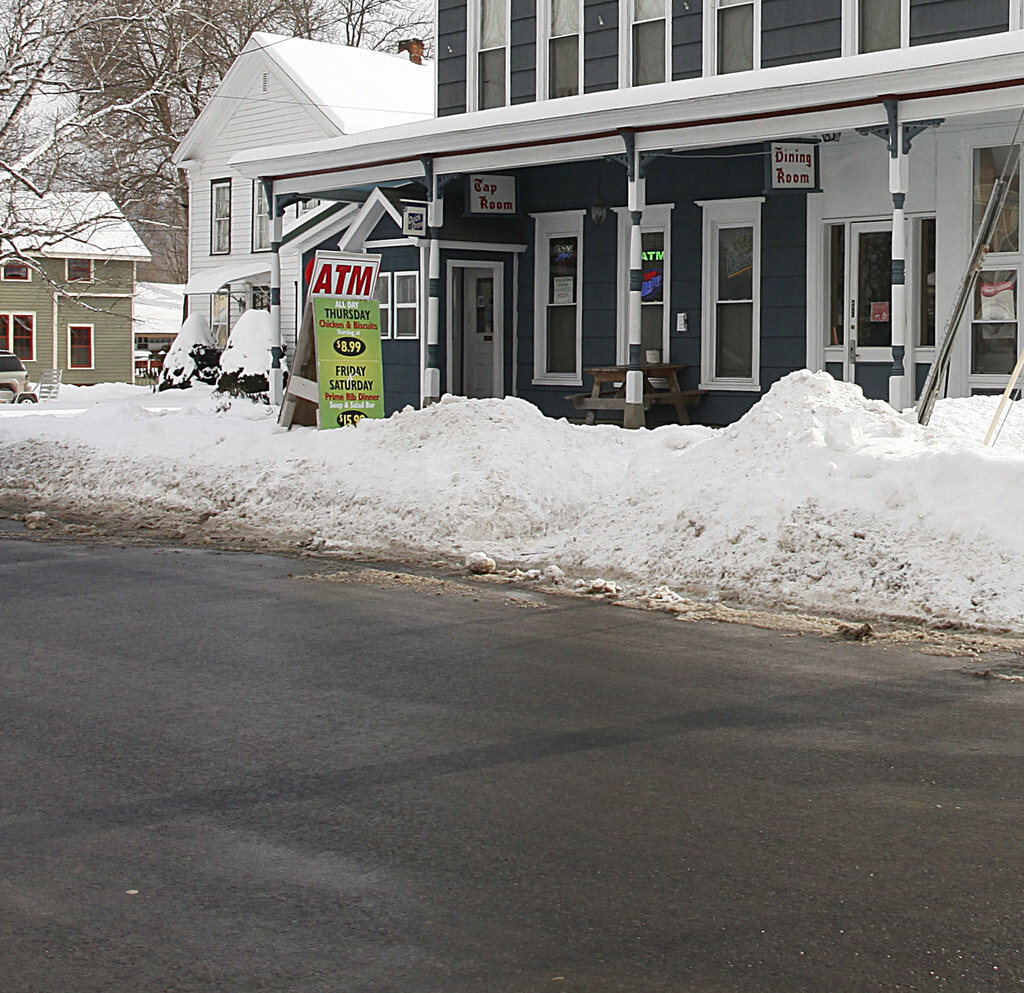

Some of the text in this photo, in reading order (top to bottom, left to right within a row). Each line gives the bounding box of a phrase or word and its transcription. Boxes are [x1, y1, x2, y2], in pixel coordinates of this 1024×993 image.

[774, 146, 812, 168] Dining
[775, 166, 810, 184] Room
[473, 178, 498, 195] Tap
[478, 195, 513, 210] Room
[641, 251, 665, 261] ATM
[312, 263, 374, 296] ATM
[334, 300, 359, 309] ALL DAY
[324, 308, 371, 320] THURSDAY
[318, 319, 378, 330] Chicken & Biscuits
[336, 340, 361, 353] $8.99
[335, 366, 366, 377] FRIDAY
[329, 379, 374, 391] SATURDAY
[324, 392, 380, 401] Prime Rib Dinner
[329, 401, 343, 410] Soup
